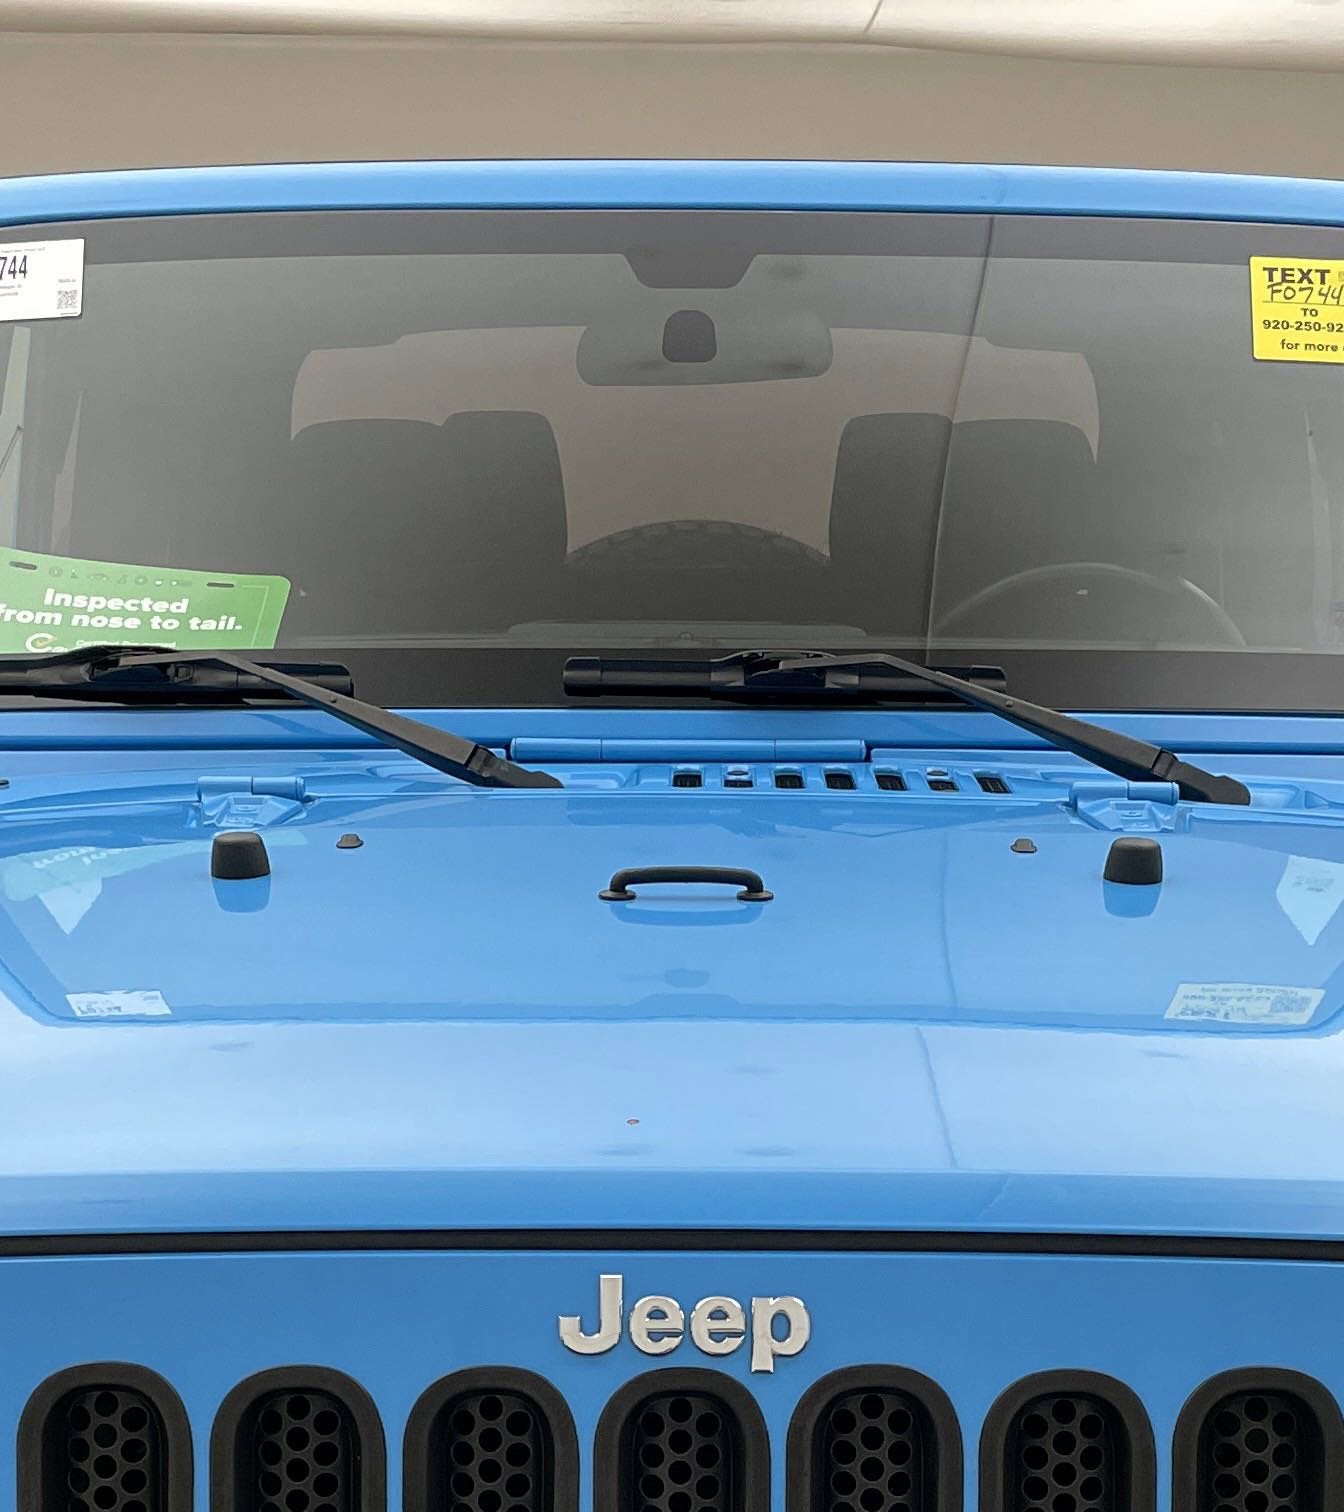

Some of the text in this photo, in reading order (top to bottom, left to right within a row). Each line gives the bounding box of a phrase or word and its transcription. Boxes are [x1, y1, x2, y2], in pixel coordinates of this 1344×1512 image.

[1262, 266, 1331, 285] TEXT
[1301, 307, 1319, 317] TO
[1280, 338, 1300, 350] for
[1304, 342, 1338, 352] more
[43, 587, 189, 614] Inspected
[71, 613, 141, 630] nose
[150, 615, 180, 631] to
[188, 615, 243, 631] tail.
[558, 1273, 811, 1374] Jeep
